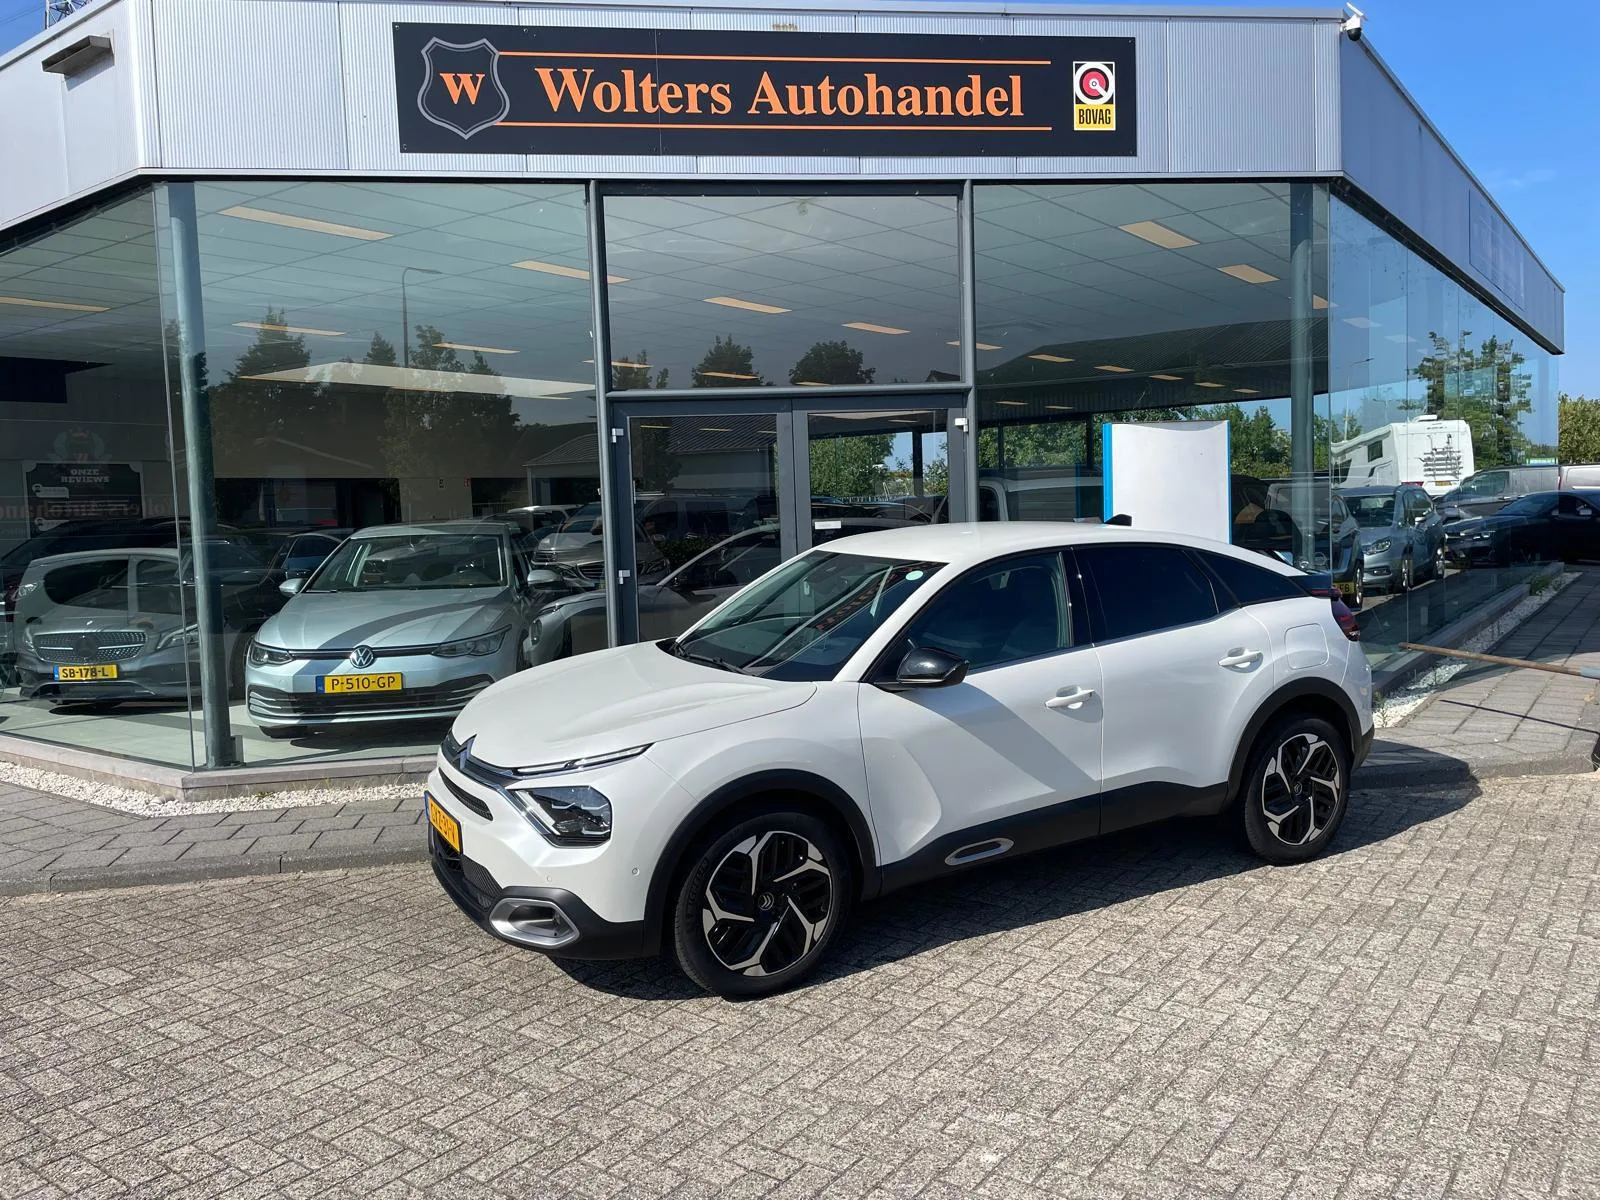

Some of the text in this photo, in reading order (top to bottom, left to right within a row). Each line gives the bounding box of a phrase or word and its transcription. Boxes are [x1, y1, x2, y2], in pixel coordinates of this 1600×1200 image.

[439, 72, 486, 105] W
[533, 67, 1025, 117] Wolters Autohandel
[1078, 108, 1112, 125] BOVAG
[60, 475, 110, 483] REVIEWS
[70, 468, 100, 476] ONZE
[61, 666, 109, 679] SB-178-L
[331, 675, 396, 691] P-510-GP
